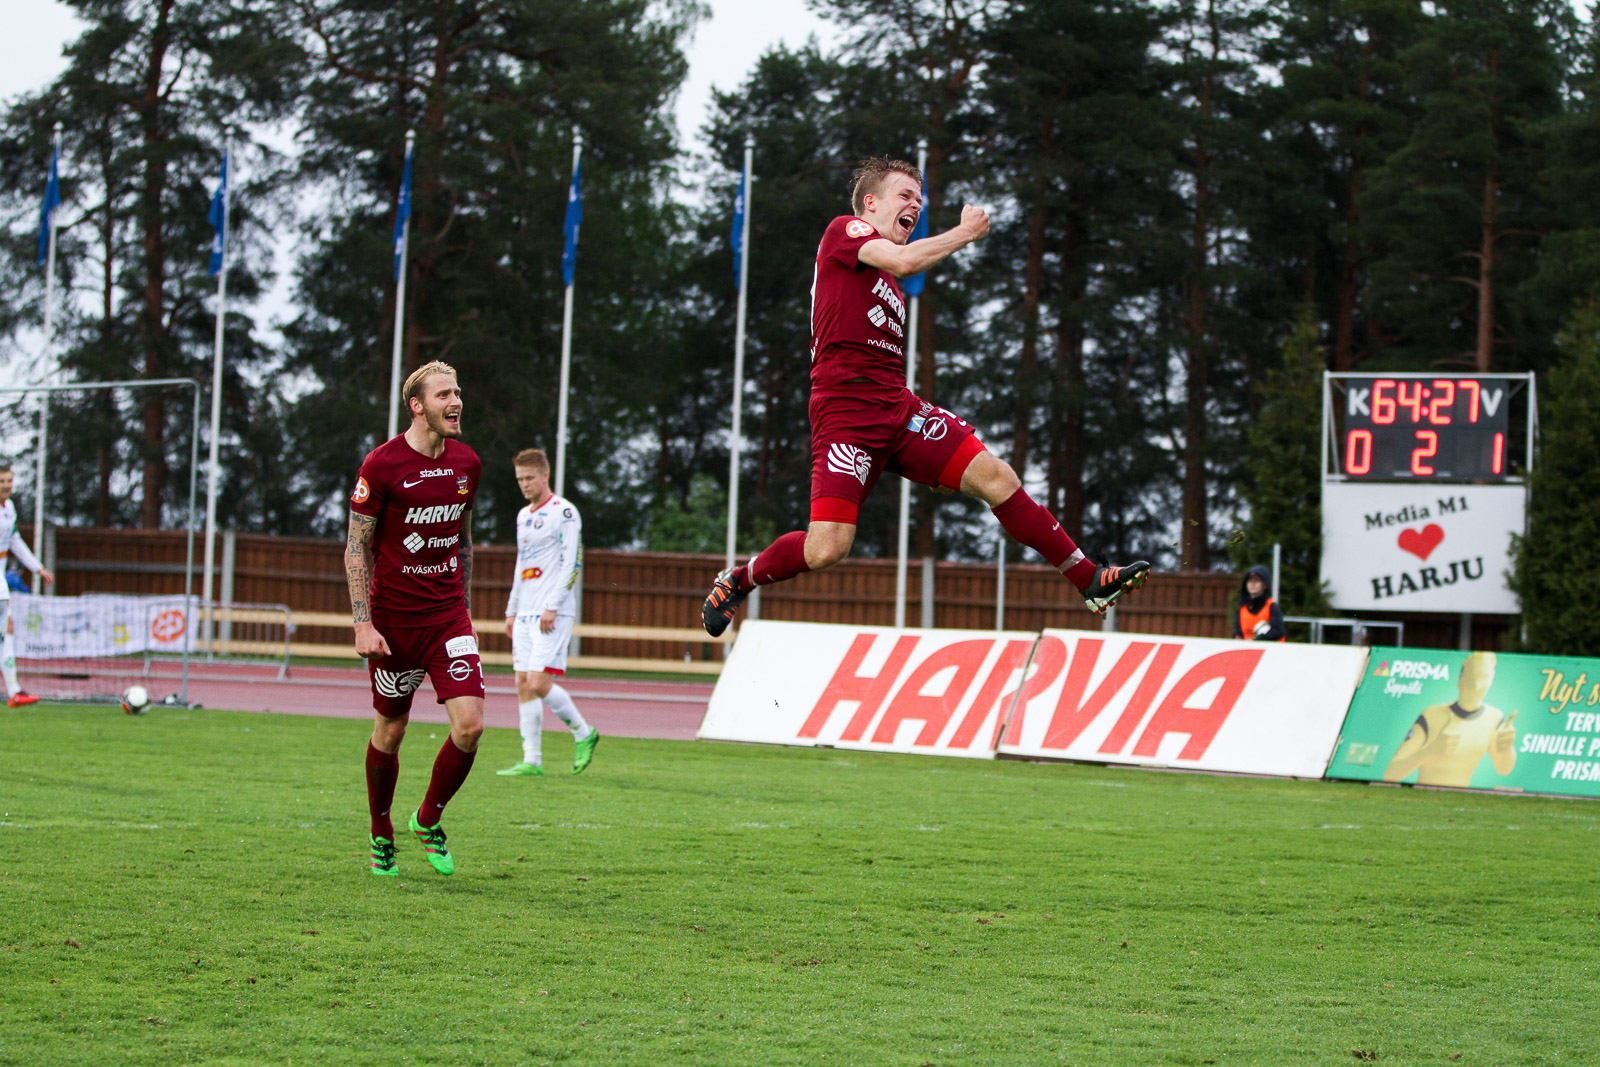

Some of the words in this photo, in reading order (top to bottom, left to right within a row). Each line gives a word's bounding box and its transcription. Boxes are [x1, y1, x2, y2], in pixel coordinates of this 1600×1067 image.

[1349, 388, 1370, 416] K
[1371, 379, 1480, 424] 64:27
[1481, 388, 1503, 417] V
[1346, 429, 1372, 474] 0
[1411, 430, 1438, 475] 2
[1492, 432, 1504, 475] 1
[419, 468, 454, 478] stadium
[1364, 505, 1430, 530] Media
[1437, 496, 1469, 517] M1
[401, 562, 449, 575] JYVÄSKYLÄ
[1370, 556, 1484, 600] HARJU
[1390, 660, 1449, 681] PRISMA
[796, 633, 1265, 761] HARVIA
[1539, 668, 1587, 714] Nyt
[1520, 733, 1587, 756] SINULLE
